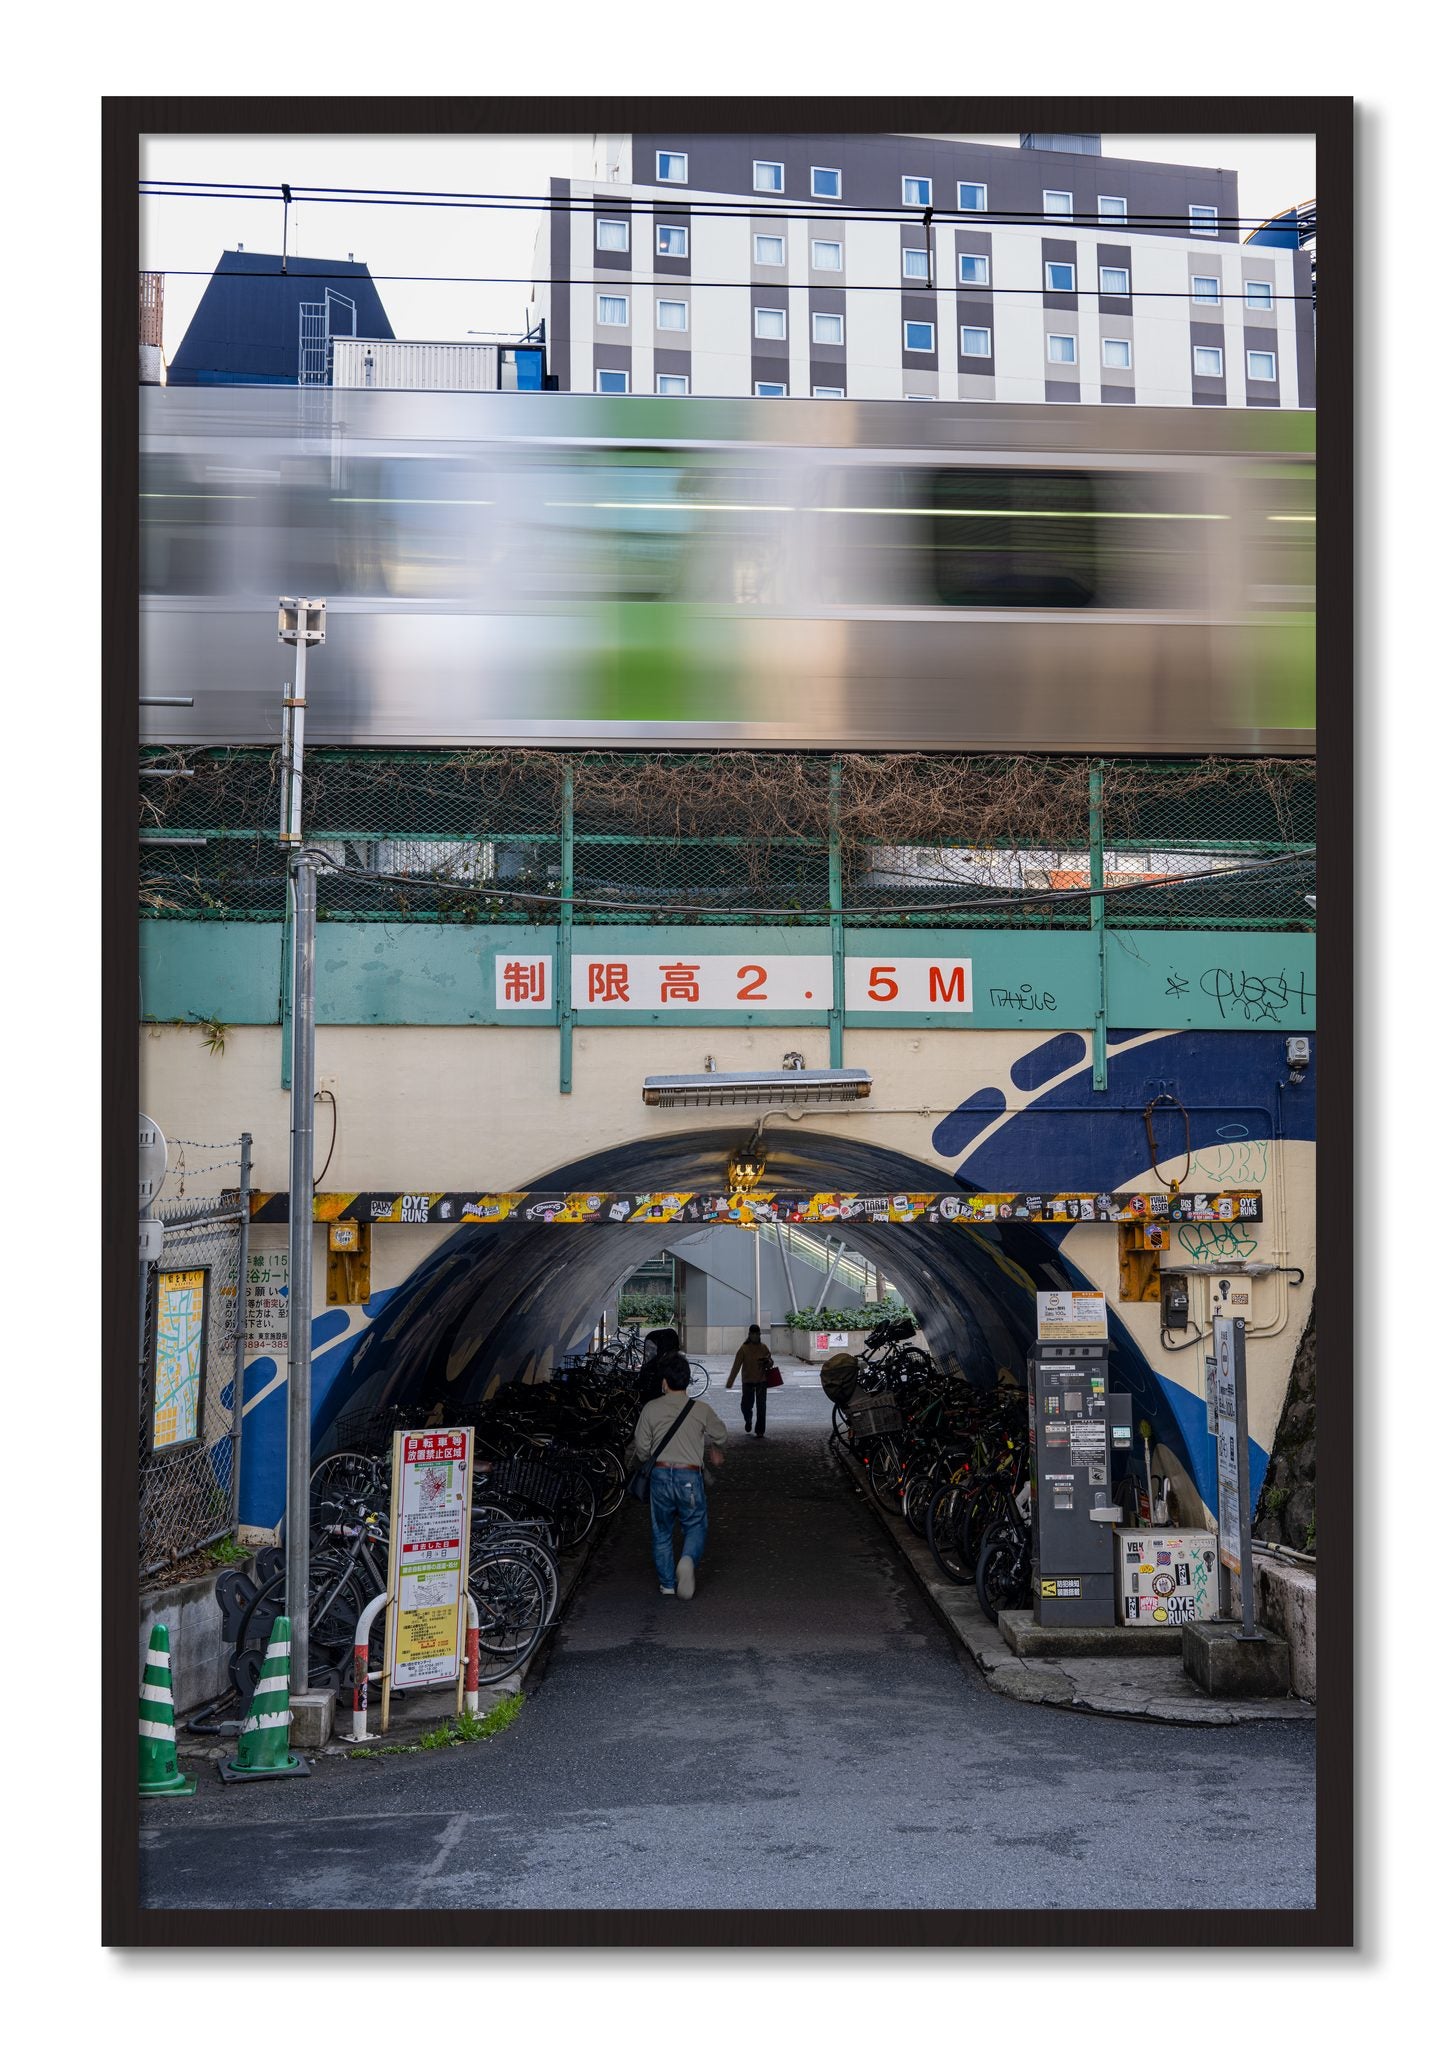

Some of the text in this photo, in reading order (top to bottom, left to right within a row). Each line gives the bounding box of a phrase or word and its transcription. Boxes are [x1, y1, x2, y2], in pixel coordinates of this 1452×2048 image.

[402, 1195, 429, 1209] OYE
[1240, 1198, 1256, 1206] OYE
[401, 1209, 429, 1222] RUNS
[1240, 1206, 1257, 1215] RUNS
[408, 1436, 462, 1449] 自転車等
[408, 1448, 462, 1461] 放置禁止区域
[1168, 1597, 1194, 1610] OYE
[1168, 1610, 1195, 1624] RUNS
